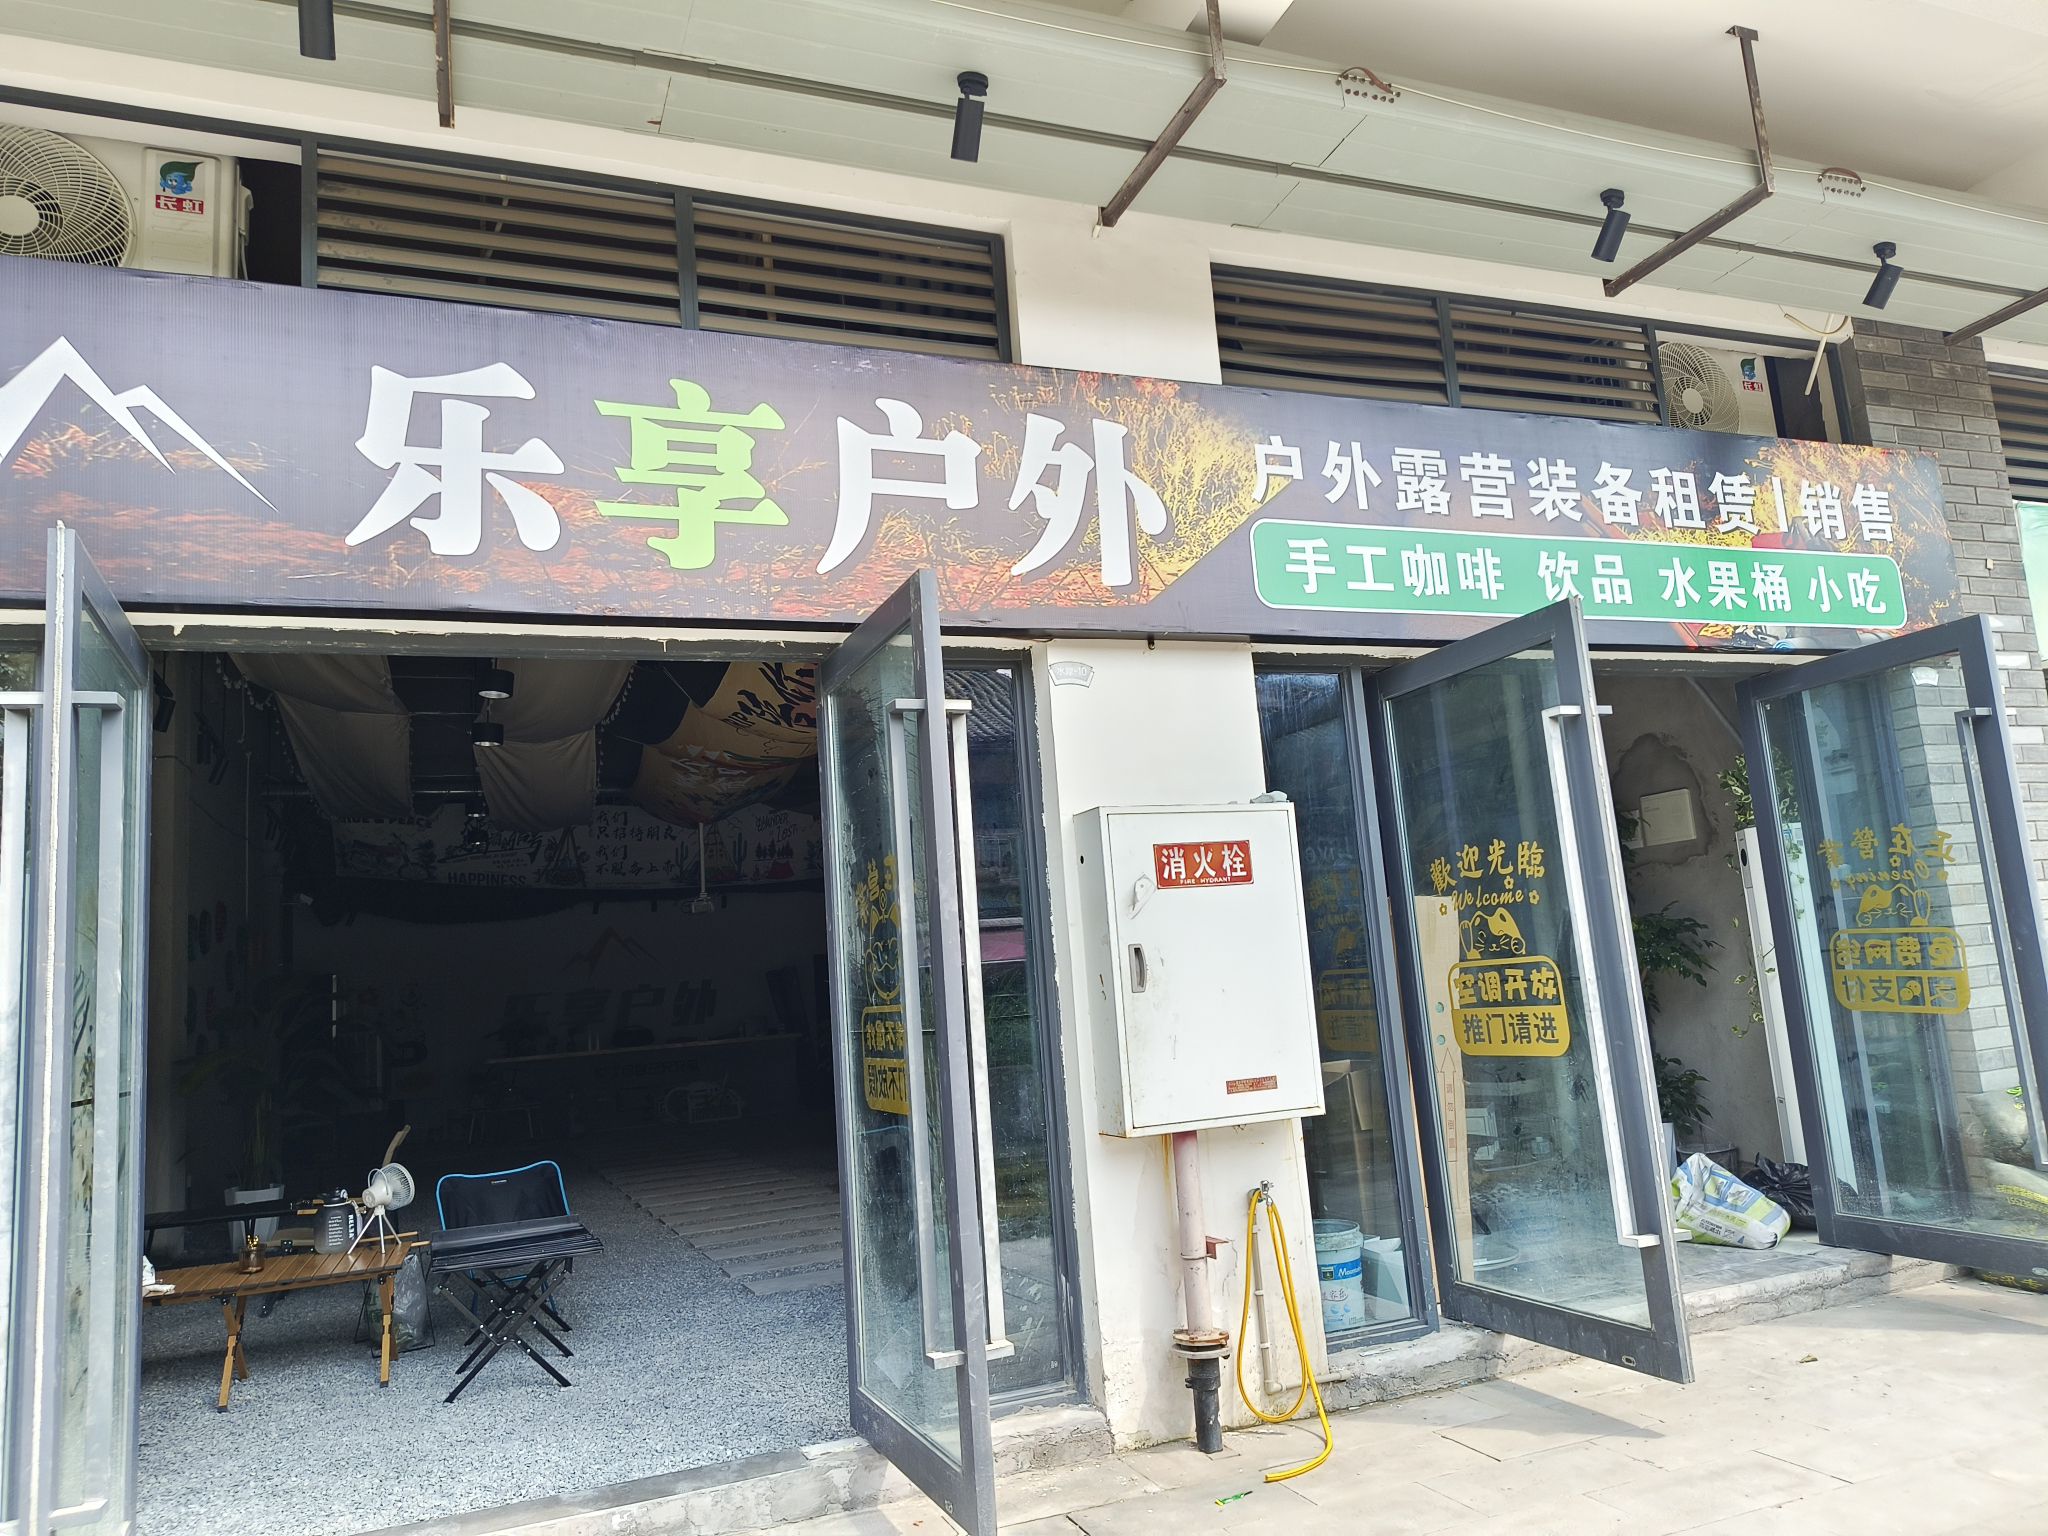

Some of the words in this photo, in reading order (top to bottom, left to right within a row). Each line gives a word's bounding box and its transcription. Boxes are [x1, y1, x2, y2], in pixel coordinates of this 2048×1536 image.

[156, 196, 202, 214] 长虹
[345, 362, 1168, 587] 乐享户外
[1285, 537, 1505, 601] 手工咖啡
[1537, 550, 1633, 605] 饮品
[1658, 557, 1792, 613] 水果桶
[1808, 565, 1887, 615] 小吃
[1161, 843, 1248, 880] 消火栓
[1200, 876, 1231, 884] HYDRANT
[1451, 885, 1524, 911] Welcome
[1454, 966, 1557, 1005] 空调开放
[1462, 1011, 1560, 1044] 推门请进
